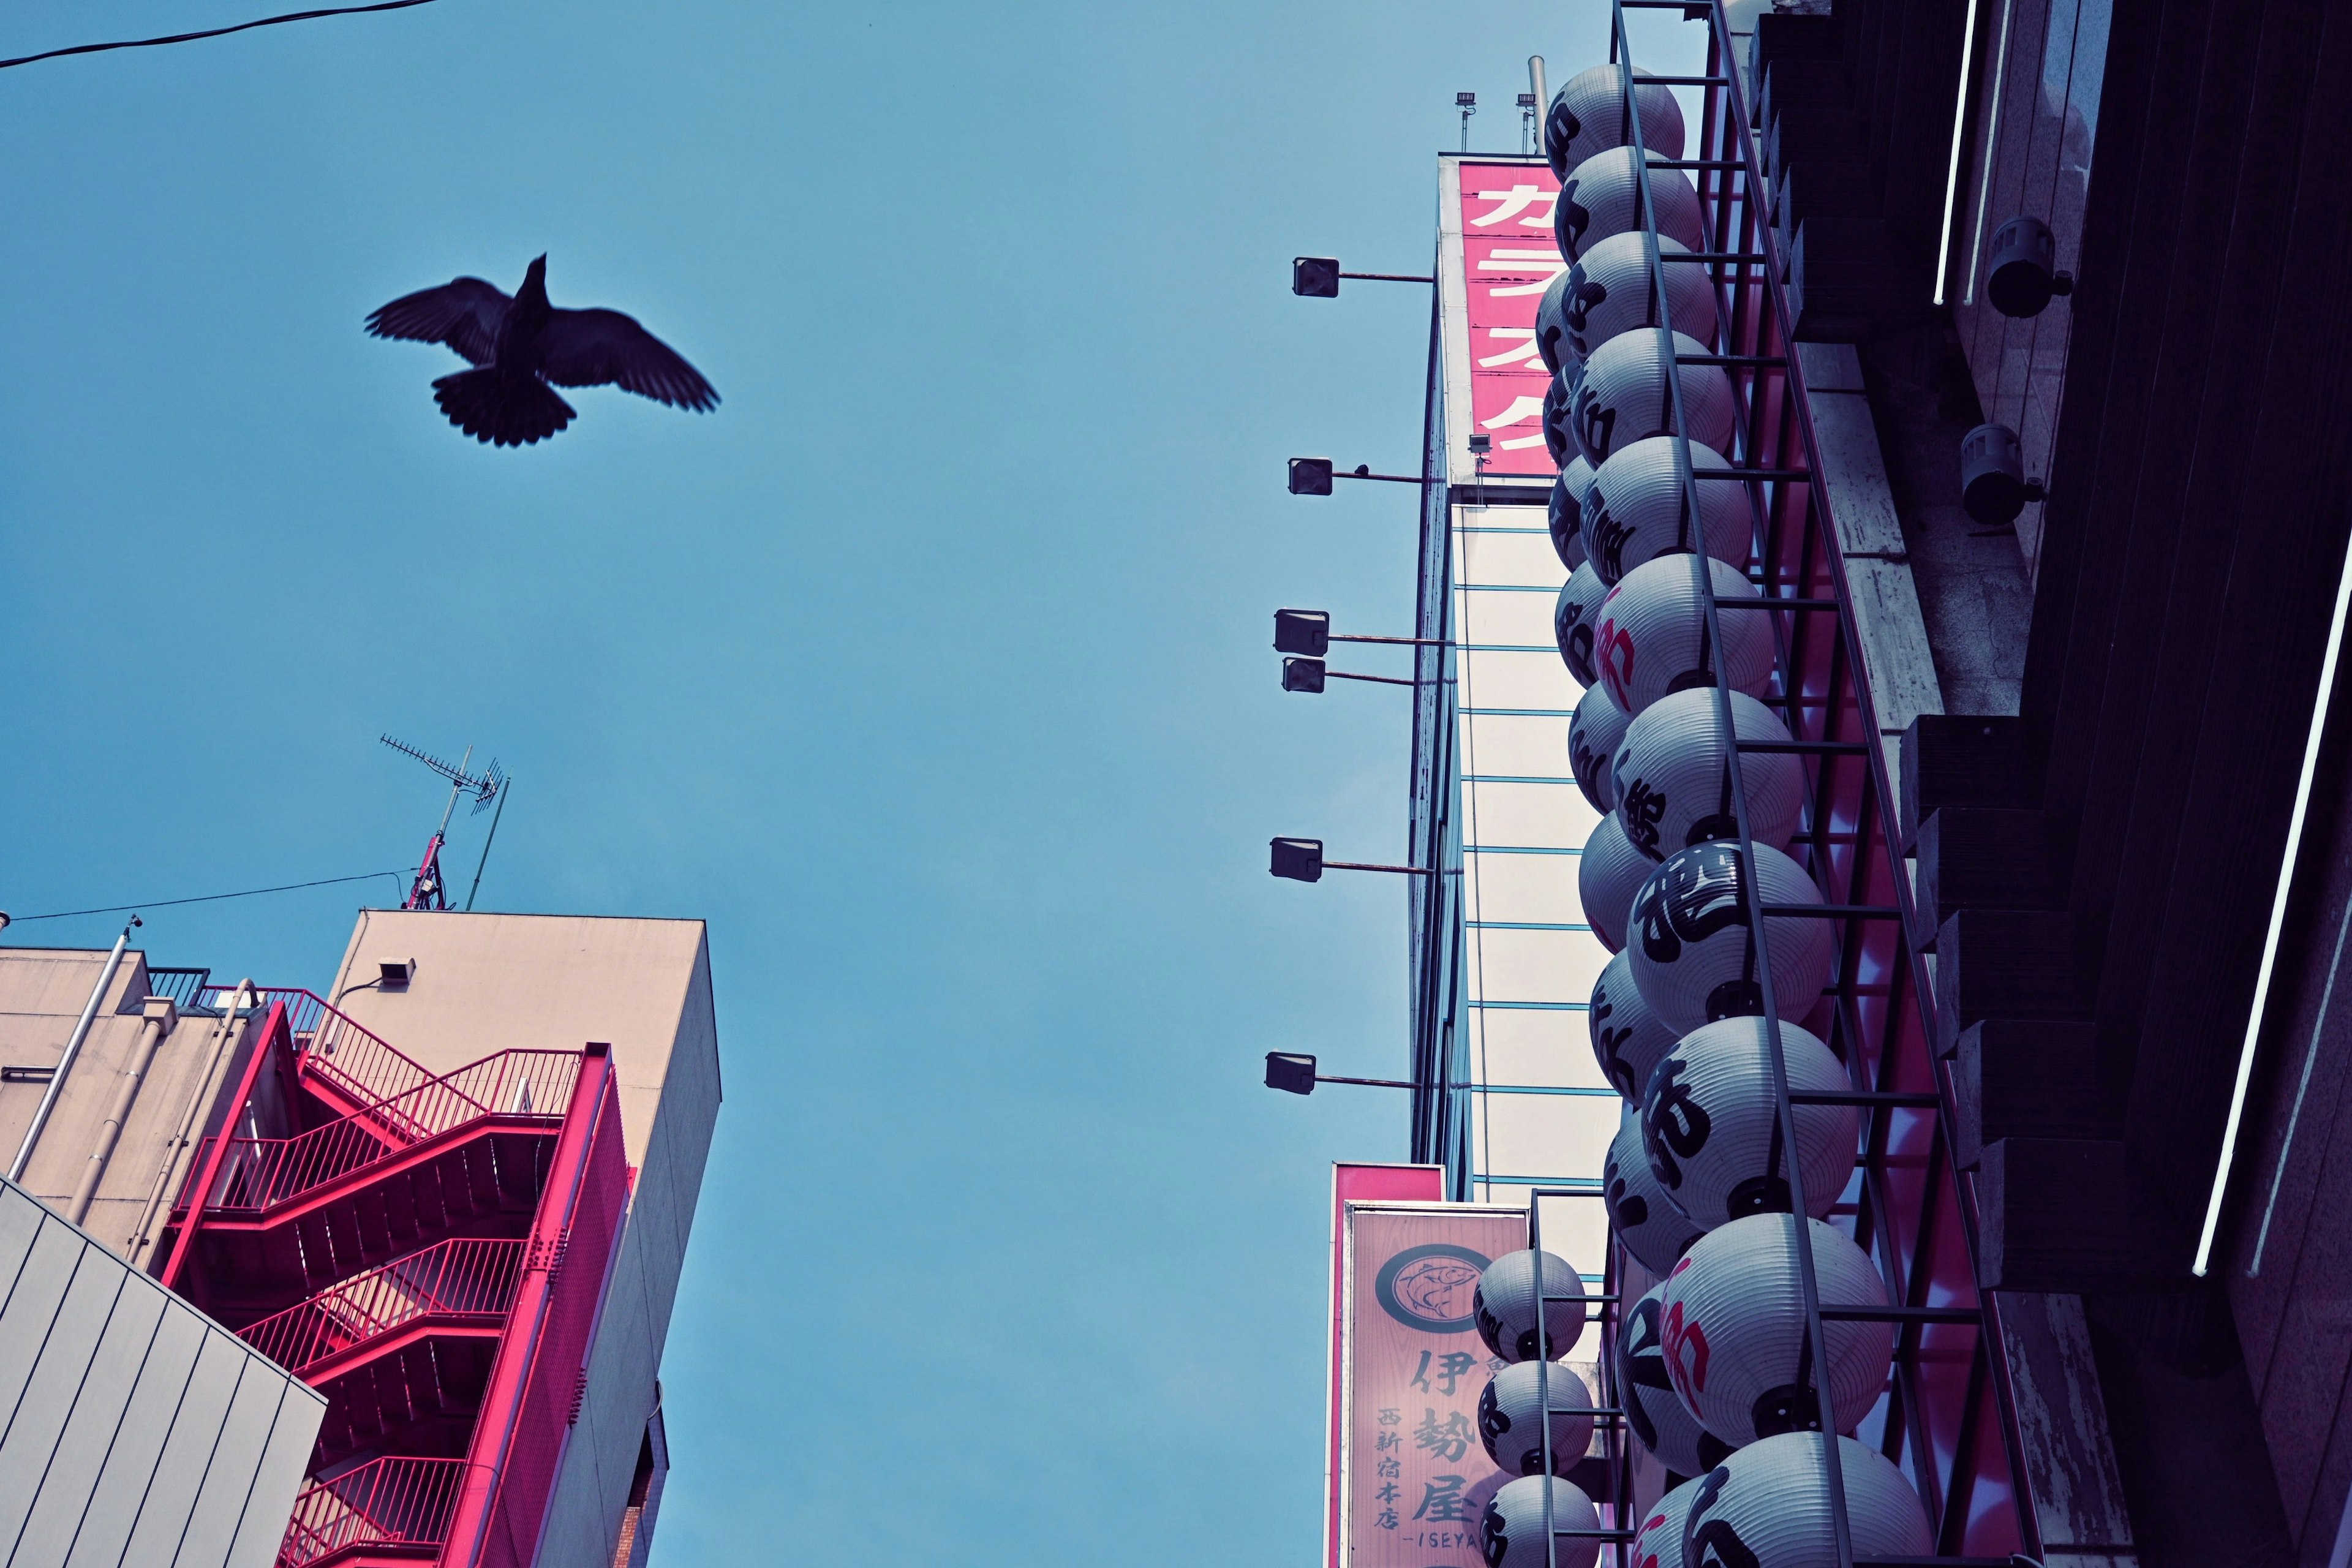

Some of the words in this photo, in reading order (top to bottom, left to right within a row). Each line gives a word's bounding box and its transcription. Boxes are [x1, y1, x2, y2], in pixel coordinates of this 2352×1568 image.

[1374, 1408, 1403, 1531] 西新宿本店
[1410, 1349, 1478, 1524] 伊勢屋
